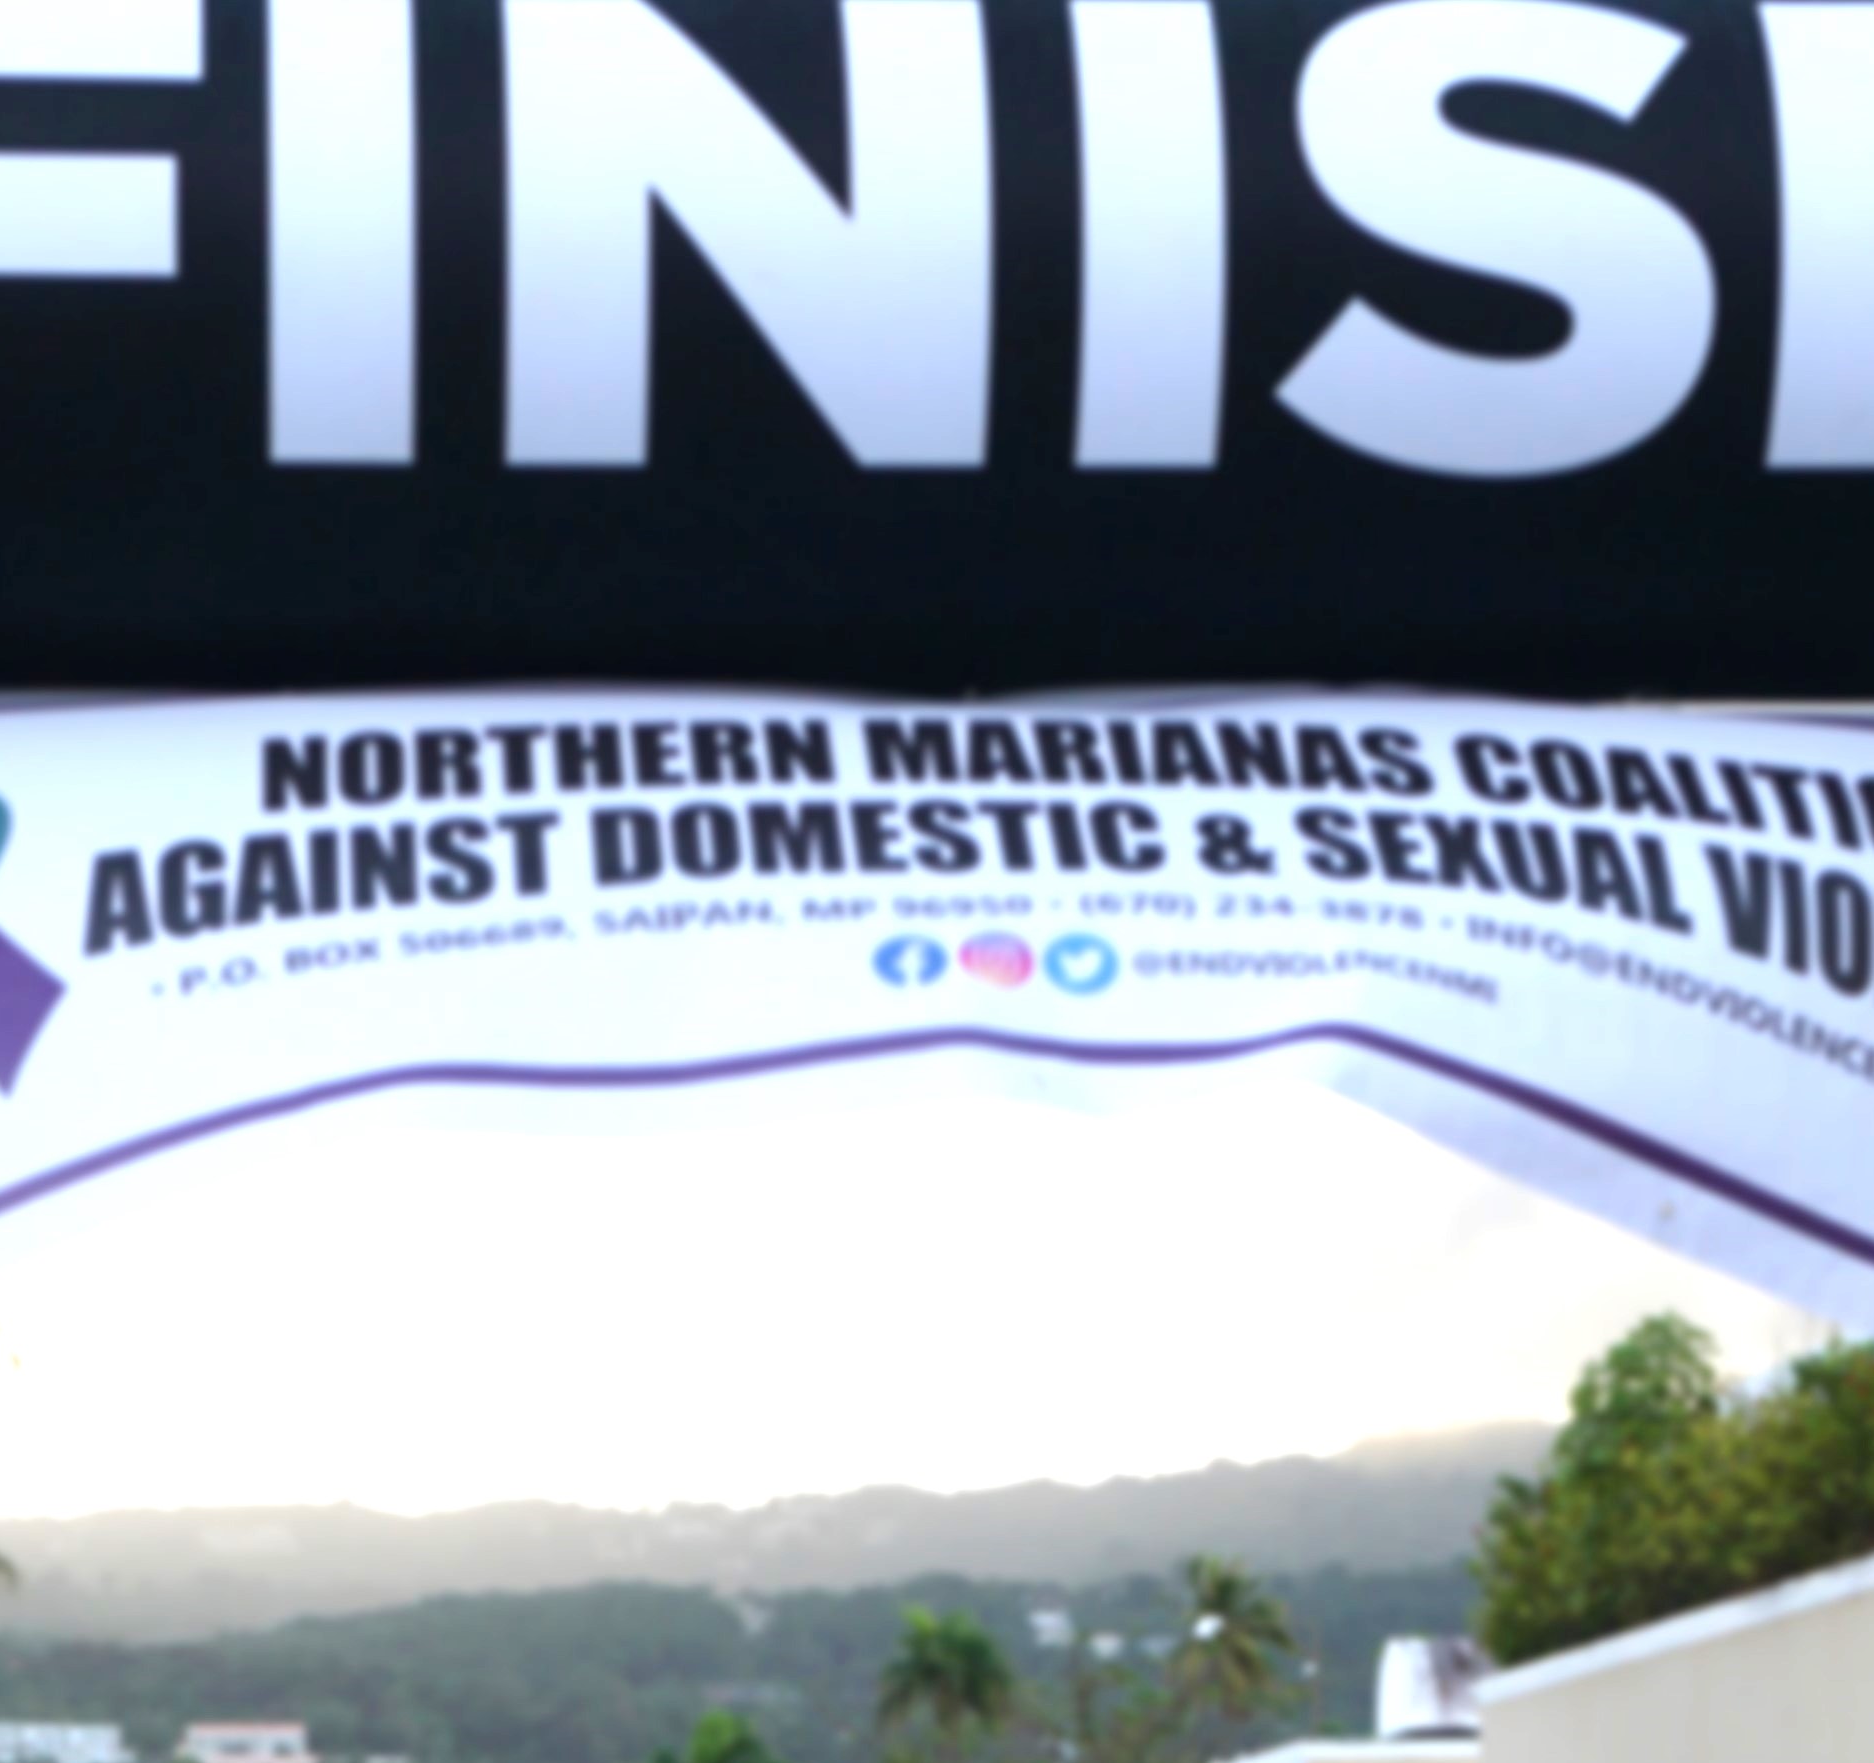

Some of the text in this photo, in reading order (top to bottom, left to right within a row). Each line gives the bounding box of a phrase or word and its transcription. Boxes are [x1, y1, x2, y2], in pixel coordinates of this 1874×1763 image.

[261, 718, 834, 814] NORTHERN
[864, 717, 1434, 798] MARIANAS
[83, 810, 560, 957] AGAINST
[590, 799, 1166, 887] DOMESTIC
[1197, 812, 1277, 877] &
[1295, 806, 1694, 936] SEXUAL
[285, 938, 381, 974] BOX
[802, 897, 877, 920] MP
[893, 893, 1034, 919] 96950
[1080, 892, 1198, 920] (670)
